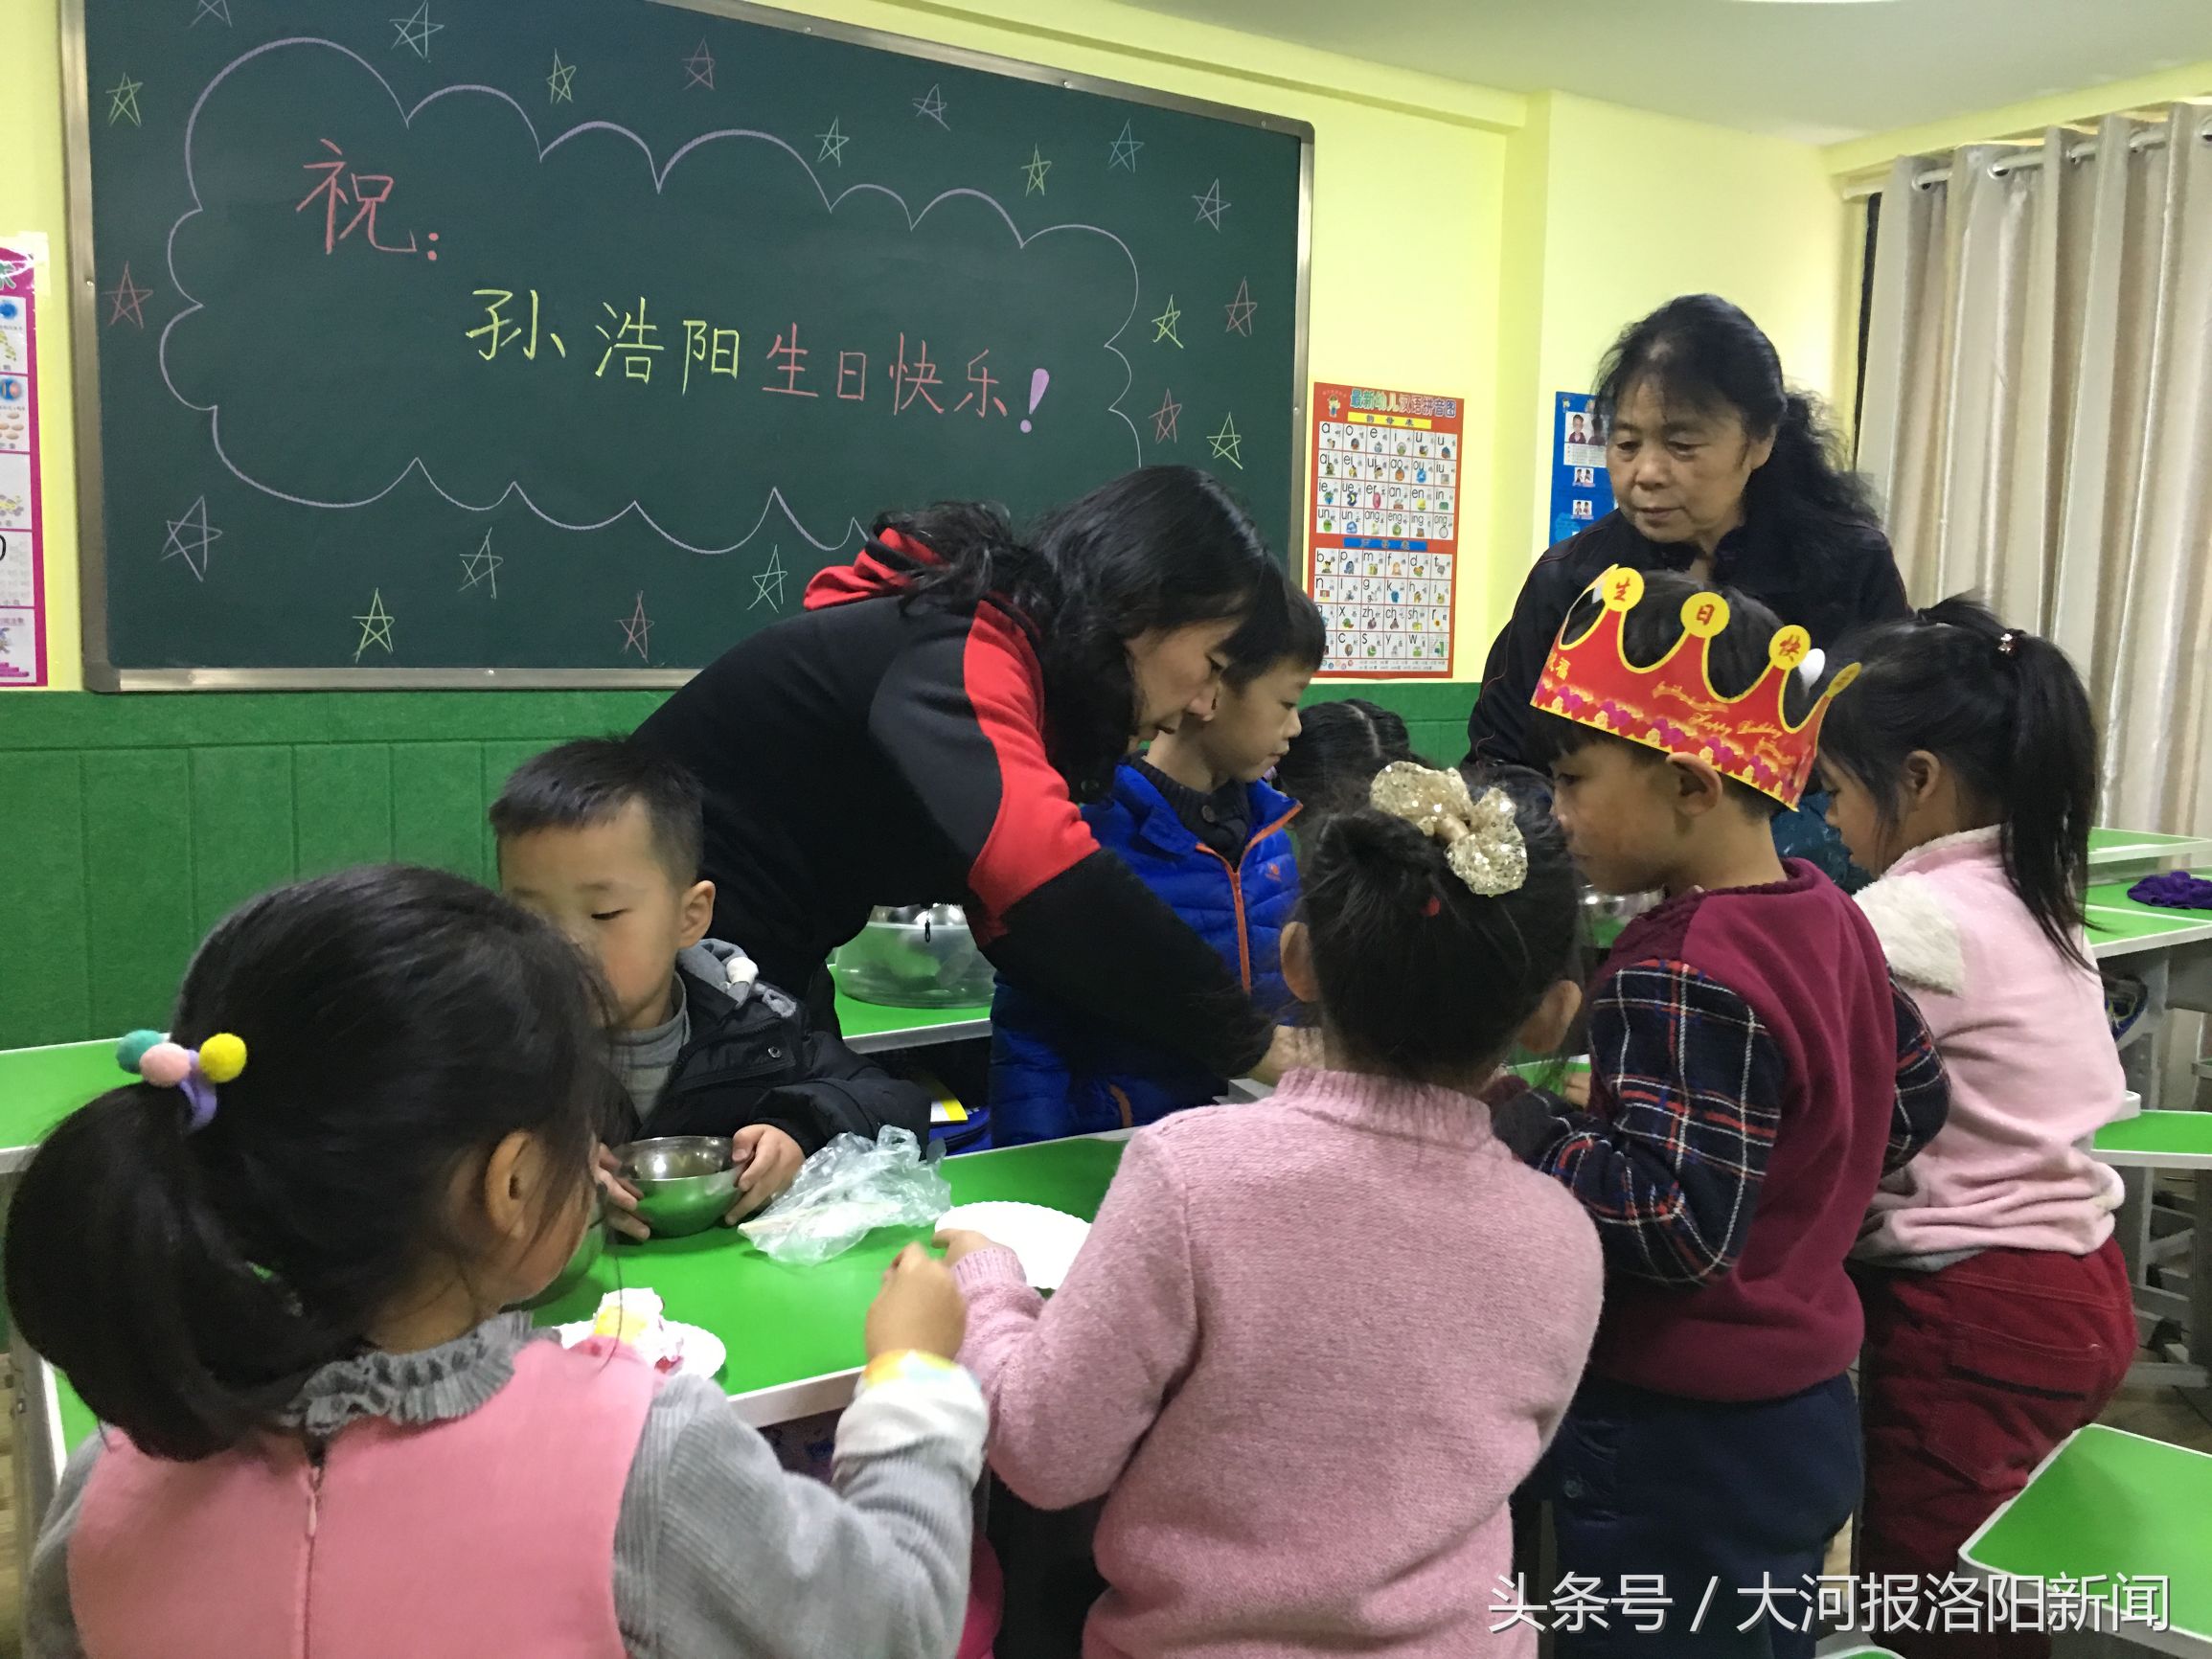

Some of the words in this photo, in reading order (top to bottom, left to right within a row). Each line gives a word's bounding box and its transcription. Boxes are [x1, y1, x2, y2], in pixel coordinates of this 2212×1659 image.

[296, 138, 440, 261] 祝：
[464, 288, 1051, 434] 孙浩阳生日快乐！
[1321, 422, 1331, 434] a
[1345, 425, 1354, 436] o
[1369, 427, 1379, 439] e
[1415, 432, 1423, 443] u
[1411, 489, 1425, 499] en
[1316, 551, 1325, 562] b
[1339, 551, 1348, 563] p
[1363, 552, 1374, 561] m
[1409, 555, 1418, 567] d
[1315, 578, 1324, 589] n
